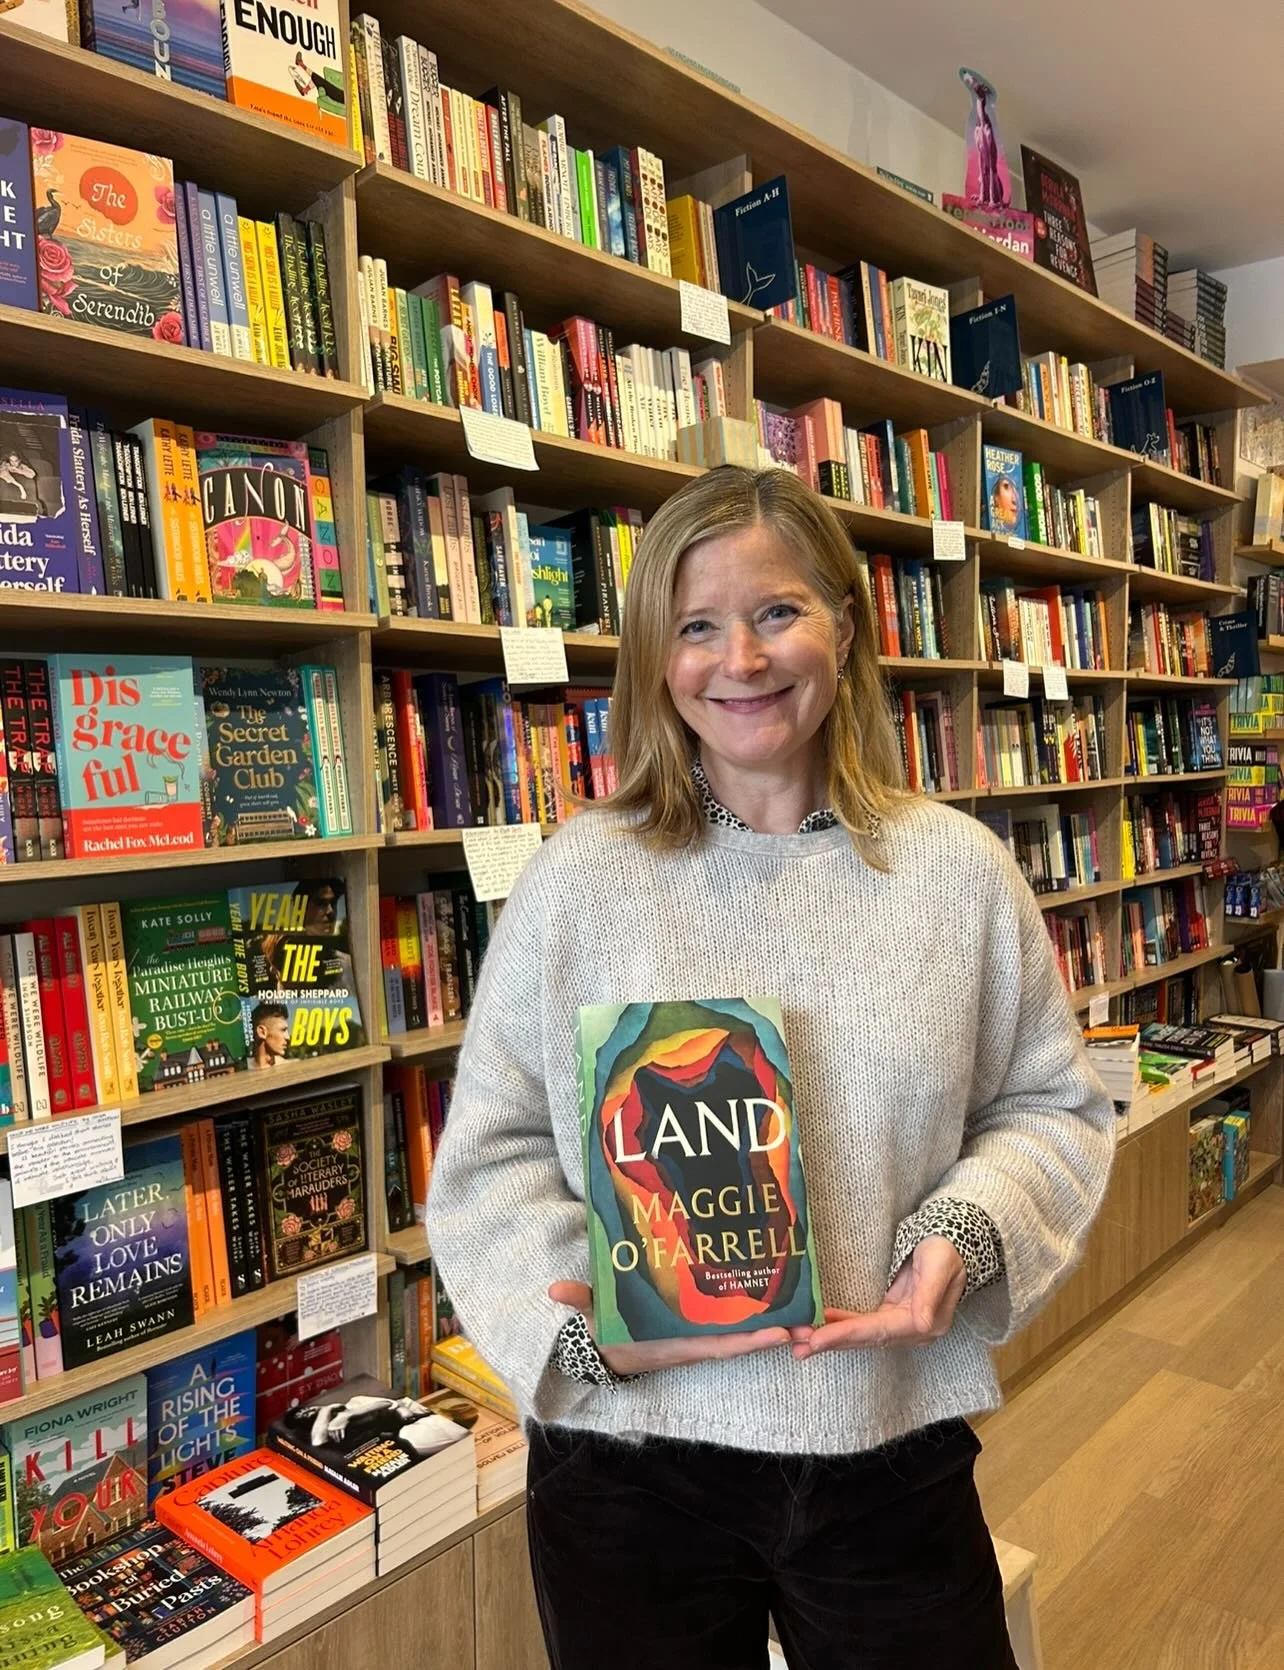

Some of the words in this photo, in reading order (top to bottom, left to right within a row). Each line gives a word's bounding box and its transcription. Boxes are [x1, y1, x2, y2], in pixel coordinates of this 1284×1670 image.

[234, 0, 336, 59] ENOUGH
[408, 90, 425, 138] Dream
[499, 95, 509, 122] AFTER
[502, 125, 510, 140] THE
[503, 142, 512, 163] FALL
[92, 182, 126, 209] The
[735, 198, 761, 217] Fiction
[764, 187, 780, 203] A-H
[201, 209, 212, 221] a
[223, 214, 234, 226] a
[76, 217, 144, 249] Sisters
[202, 222, 218, 254] little
[224, 227, 239, 258] little
[100, 262, 126, 288] of
[206, 257, 224, 306] unwell
[229, 261, 245, 310] unwell
[379, 269, 388, 297] JULIAN
[72, 293, 155, 326] Serendib
[381, 299, 389, 328] BARNES
[969, 310, 993, 325] Fiction
[534, 336, 550, 384] William
[910, 336, 948, 382] KIN
[488, 367, 496, 392] GOOD
[1121, 382, 1143, 393] Fiction
[69, 413, 80, 444] Frida
[160, 427, 173, 454] KATHY
[164, 455, 175, 477] LETTE
[986, 447, 1019, 465] HEATHER
[987, 460, 1005, 473] ROSE
[72, 447, 86, 496] Slattery
[78, 495, 89, 512] As
[203, 463, 306, 532] CANON
[80, 514, 96, 556] Herself
[495, 545, 504, 563] SAFE
[497, 564, 506, 587] HAVEN
[601, 582, 611, 629] PIRANESI
[1226, 623, 1248, 631] Thriller
[5, 666, 24, 710] THE
[29, 667, 48, 712] THE
[69, 665, 141, 706] Dis
[209, 688, 236, 698] Wendy
[238, 688, 258, 699] Lynn
[260, 688, 292, 697] Newton
[237, 704, 267, 724] The
[381, 675, 398, 766] ARBORESCENCE
[1232, 715, 1259, 728] TRIVIA
[9, 716, 29, 773] TRAP
[33, 717, 54, 774] TRAP
[72, 706, 191, 760] grace
[219, 723, 290, 744] Secret
[216, 743, 298, 767] Garden
[82, 753, 141, 802] ful
[234, 768, 284, 790] Club
[1230, 807, 1256, 821] TRIVIA
[84, 836, 124, 852] Rachel
[126, 836, 147, 849] Fox
[149, 832, 194, 847] McLeod
[141, 916, 171, 929] KATE
[177, 912, 212, 924] SOLLY
[230, 903, 242, 932] YEAH
[250, 892, 309, 931] YEAH
[147, 954, 160, 964] the
[233, 938, 246, 958] THE
[282, 943, 322, 983] THE
[26, 950, 37, 978] ONCE
[133, 960, 184, 978] Paradise
[187, 955, 231, 971] Heights
[236, 961, 249, 993] BOYS
[30, 982, 38, 998] WE
[134, 967, 233, 997] MINIATURE
[258, 989, 298, 1000] HOLDEN
[300, 989, 349, 999] SHEPPARD
[32, 1000, 41, 1028] WERE
[149, 987, 225, 1013] RAILWAY
[24, 1002, 33, 1047] SIMPSON
[155, 1005, 222, 1031] BUST-UP
[291, 1007, 352, 1047] BOYS
[34, 1031, 45, 1077] WILDLIFE
[574, 1025, 587, 1137] LAND
[613, 1097, 786, 1163] LAND
[226, 1157, 236, 1191] WATER
[293, 1154, 338, 1174] SOCIETY
[300, 1163, 345, 1184] LITERARY
[288, 1175, 348, 1199] MARAUDERS
[230, 1197, 240, 1235] TAKES
[631, 1183, 780, 1225] MAGGIE
[93, 1211, 157, 1246] ONLY
[95, 1236, 158, 1274] LOVE
[612, 1226, 806, 1272] O'FARRELL
[70, 1253, 183, 1309] REMAINS
[705, 1268, 751, 1281] Bestselling
[753, 1266, 780, 1277] author
[719, 1281, 727, 1291] of
[730, 1278, 770, 1290] HAMNET
[86, 1327, 123, 1348] LEAH
[130, 1308, 176, 1331] SWANN
[189, 1364, 208, 1386] A
[25, 1414, 74, 1439] FIONA
[77, 1390, 138, 1417] WRIGHT
[162, 1377, 235, 1422] RISING
[158, 1421, 189, 1446] OF
[199, 1396, 240, 1427] THE
[25, 1417, 138, 1486] KILL
[161, 1423, 237, 1470] LIGHTS
[348, 1439, 394, 1467] WAITING
[366, 1453, 381, 1466] ON
[508, 1442, 526, 1454] BALL
[364, 1450, 402, 1474] FRIEND
[173, 1454, 272, 1506] Capture
[29, 1469, 138, 1542] YOUR
[267, 1511, 347, 1560] Lohrey
[59, 1565, 85, 1579] The
[64, 1542, 165, 1596] Bookshop
[126, 1572, 138, 1585] of
[112, 1568, 187, 1613] Buried
[160, 1575, 223, 1611] Pasts
[156, 1607, 217, 1641] CLUTTON
[159, 1608, 204, 1631] SARAH
